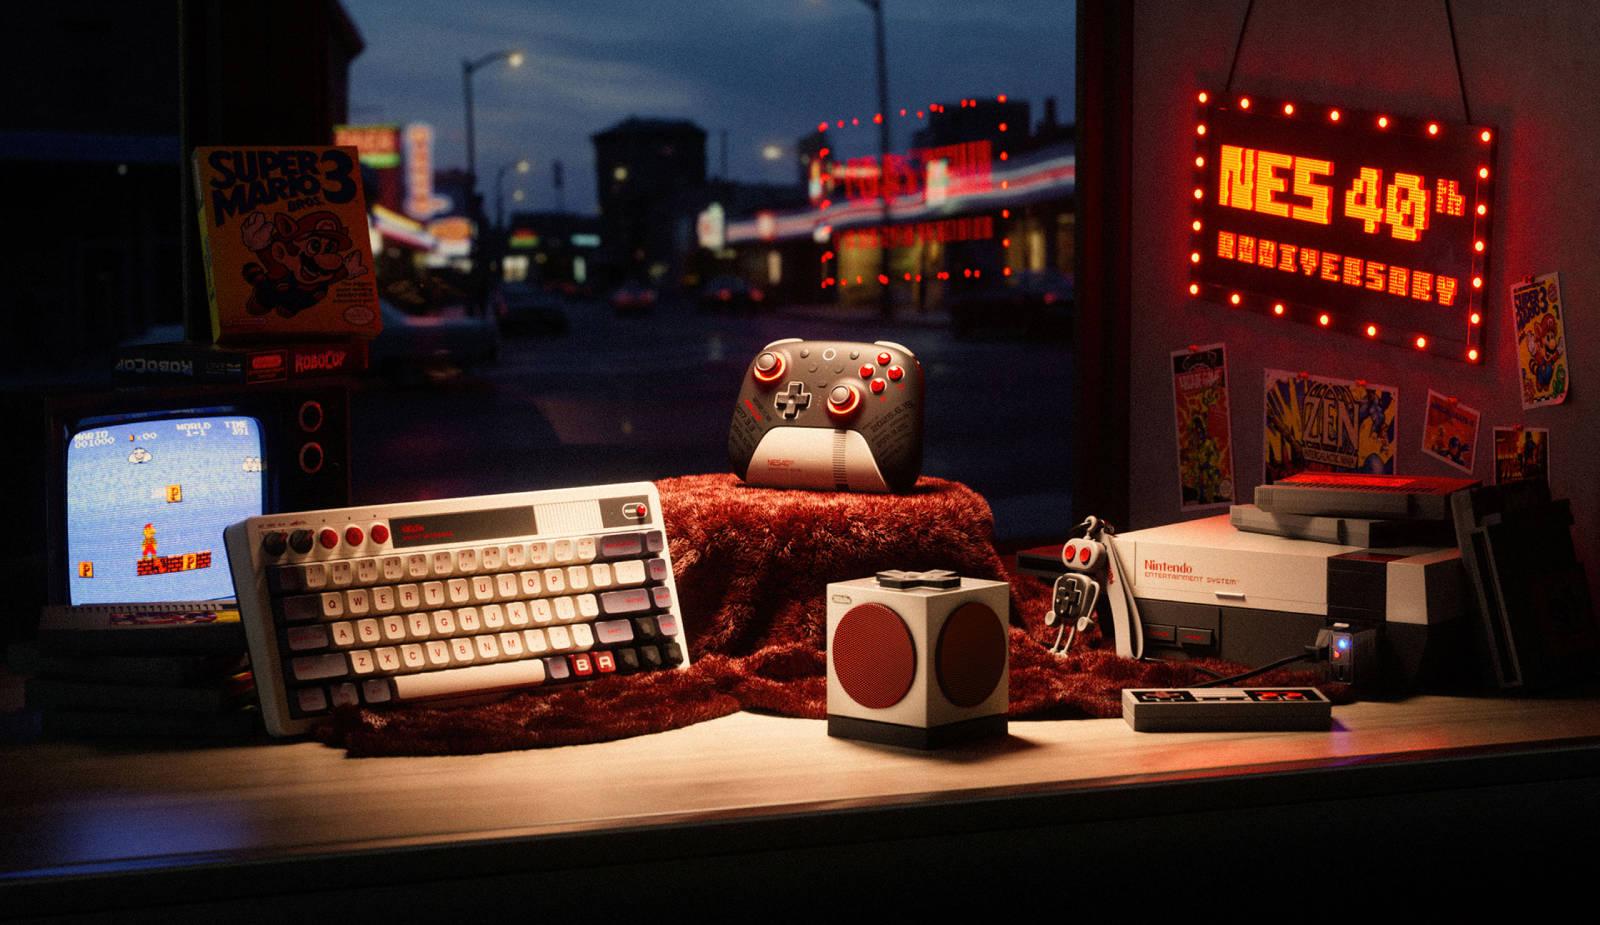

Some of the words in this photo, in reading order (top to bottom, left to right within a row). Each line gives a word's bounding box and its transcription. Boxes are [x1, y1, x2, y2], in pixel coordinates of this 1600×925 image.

[208, 150, 318, 189] SUPER
[320, 150, 357, 203] 3
[1218, 144, 1335, 225] NES
[211, 175, 321, 227] MARIO
[1218, 230, 1458, 306] ANNIVERSARY
[175, 421, 212, 432] WORLD
[1303, 396, 1361, 453] ZEN
[1144, 559, 1193, 574] Nintendo
[1144, 571, 1204, 583] ENTERTAINMENT
[328, 600, 337, 609] Q
[353, 597, 363, 606] W
[380, 594, 387, 604] E
[405, 591, 412, 601] R
[430, 589, 438, 598] T
[455, 586, 462, 595] Y
[480, 584, 487, 593] U
[551, 575, 558, 585] P
[339, 629, 347, 639] A
[365, 626, 373, 636] S
[390, 623, 398, 633] D
[416, 620, 422, 630] F
[440, 617, 449, 627] G
[465, 615, 473, 624] H
[490, 612, 496, 622] J
[513, 609, 521, 619] K
[538, 607, 545, 616] L
[358, 657, 366, 667] Z
[384, 654, 392, 664] X
[409, 651, 417, 661] C
[434, 648, 442, 657] V
[484, 642, 491, 651] N
[507, 639, 516, 648] M
[575, 658, 589, 671] B
[599, 655, 613, 669] A
